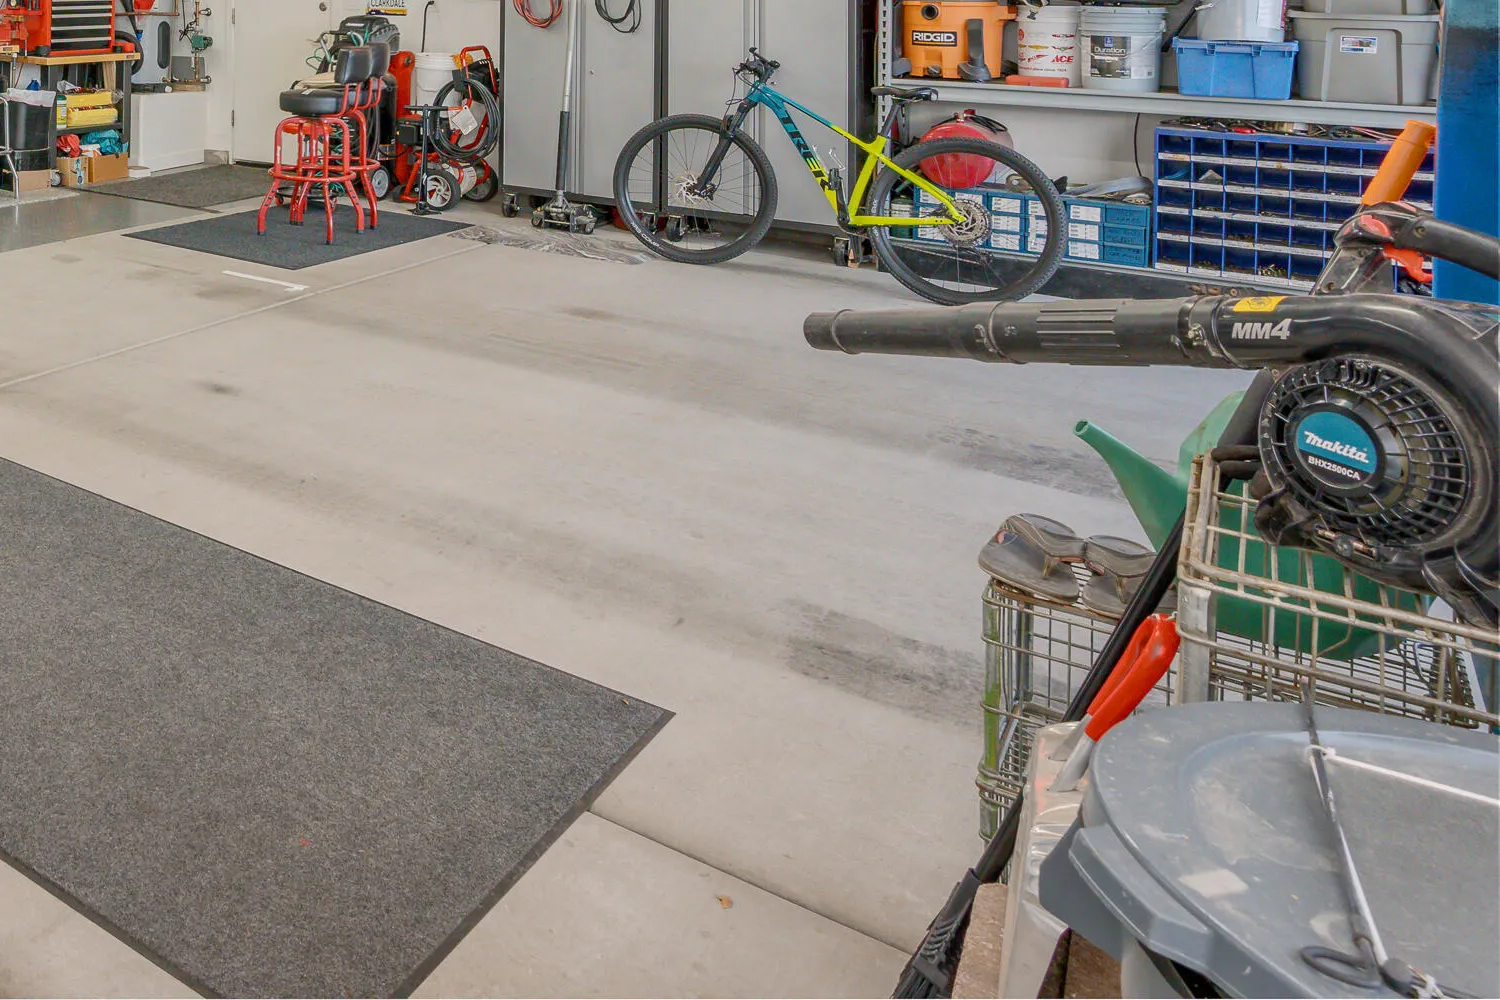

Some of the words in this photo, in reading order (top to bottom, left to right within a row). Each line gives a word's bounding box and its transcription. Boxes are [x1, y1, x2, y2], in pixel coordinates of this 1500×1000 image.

[912, 31, 955, 43] RIDGID
[1094, 46, 1127, 54] Duration
[1051, 55, 1075, 63] ACE
[1231, 318, 1292, 340] MM4
[1308, 455, 1361, 481] BHX2500CA
